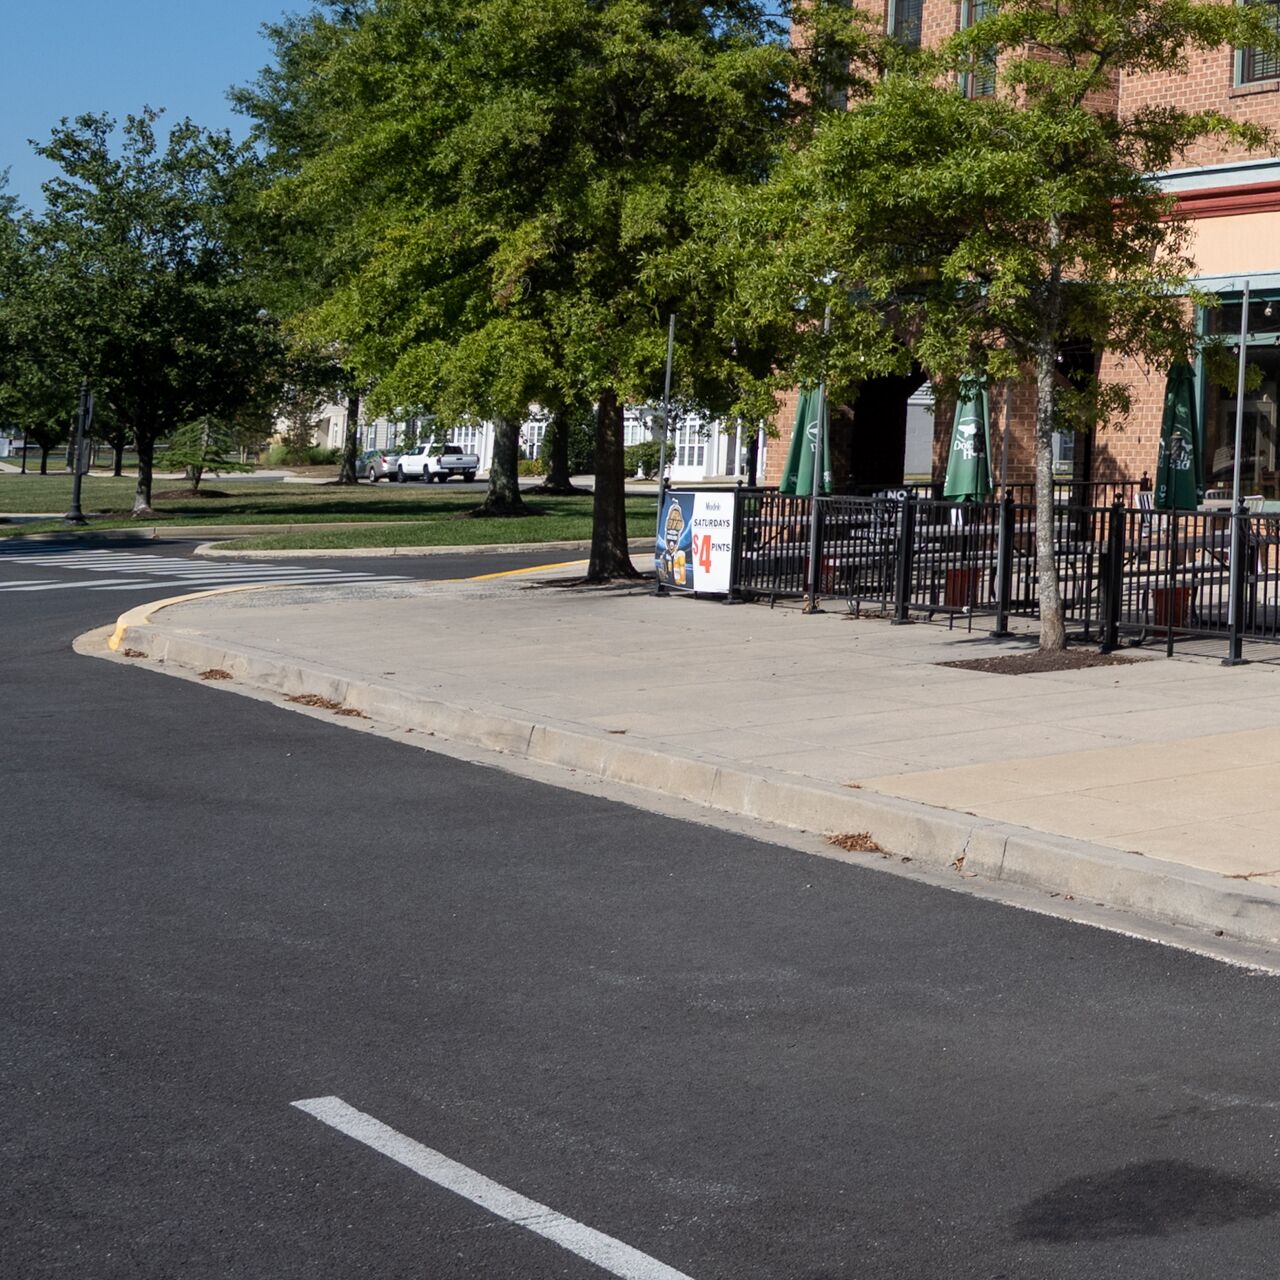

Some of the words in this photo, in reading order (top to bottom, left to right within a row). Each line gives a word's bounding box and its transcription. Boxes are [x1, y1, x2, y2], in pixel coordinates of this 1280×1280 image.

[694, 519, 731, 527] SATURDAYS
[693, 534, 712, 573] $4
[711, 543, 731, 552] PINTS
